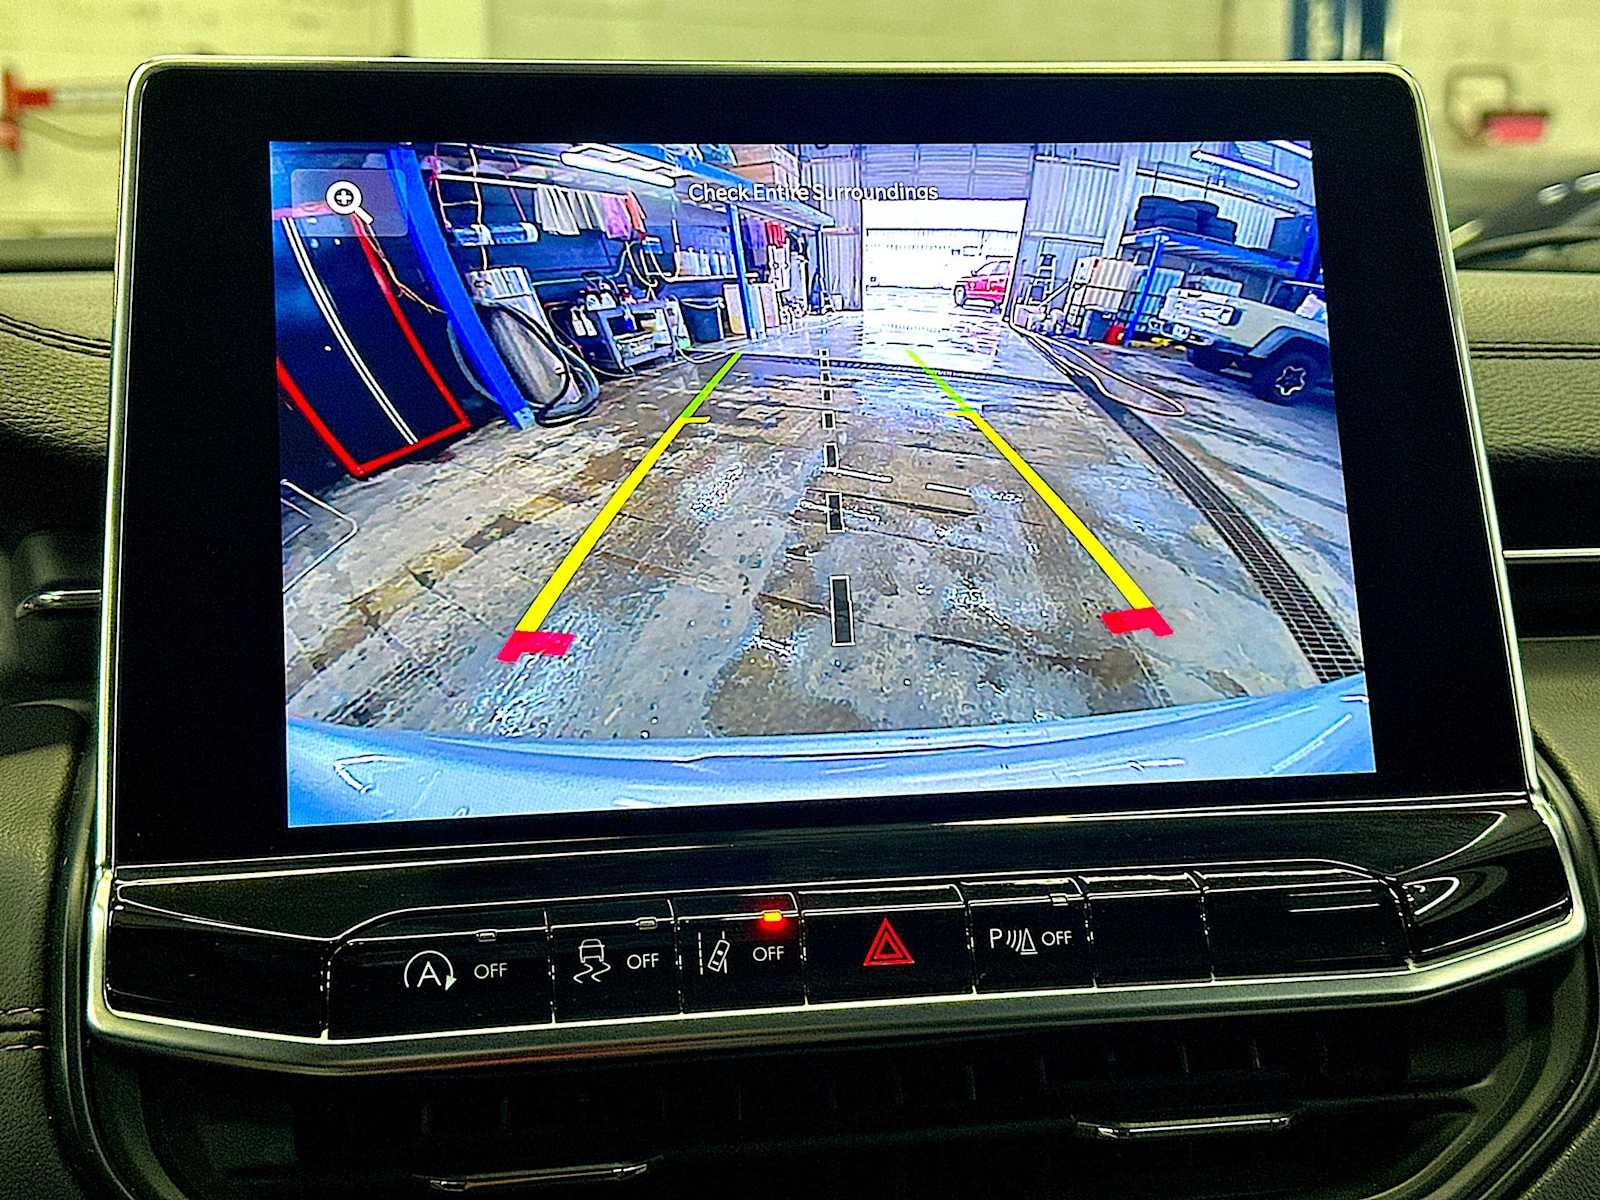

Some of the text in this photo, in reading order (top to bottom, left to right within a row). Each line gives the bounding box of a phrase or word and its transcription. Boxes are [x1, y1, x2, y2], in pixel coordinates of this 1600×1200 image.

[688, 182, 938, 201] Check Entire Surroundings
[989, 928, 1073, 949] P OFF
[626, 953, 660, 970] OFF
[752, 946, 785, 963] OFF
[417, 961, 508, 988] A OFF
